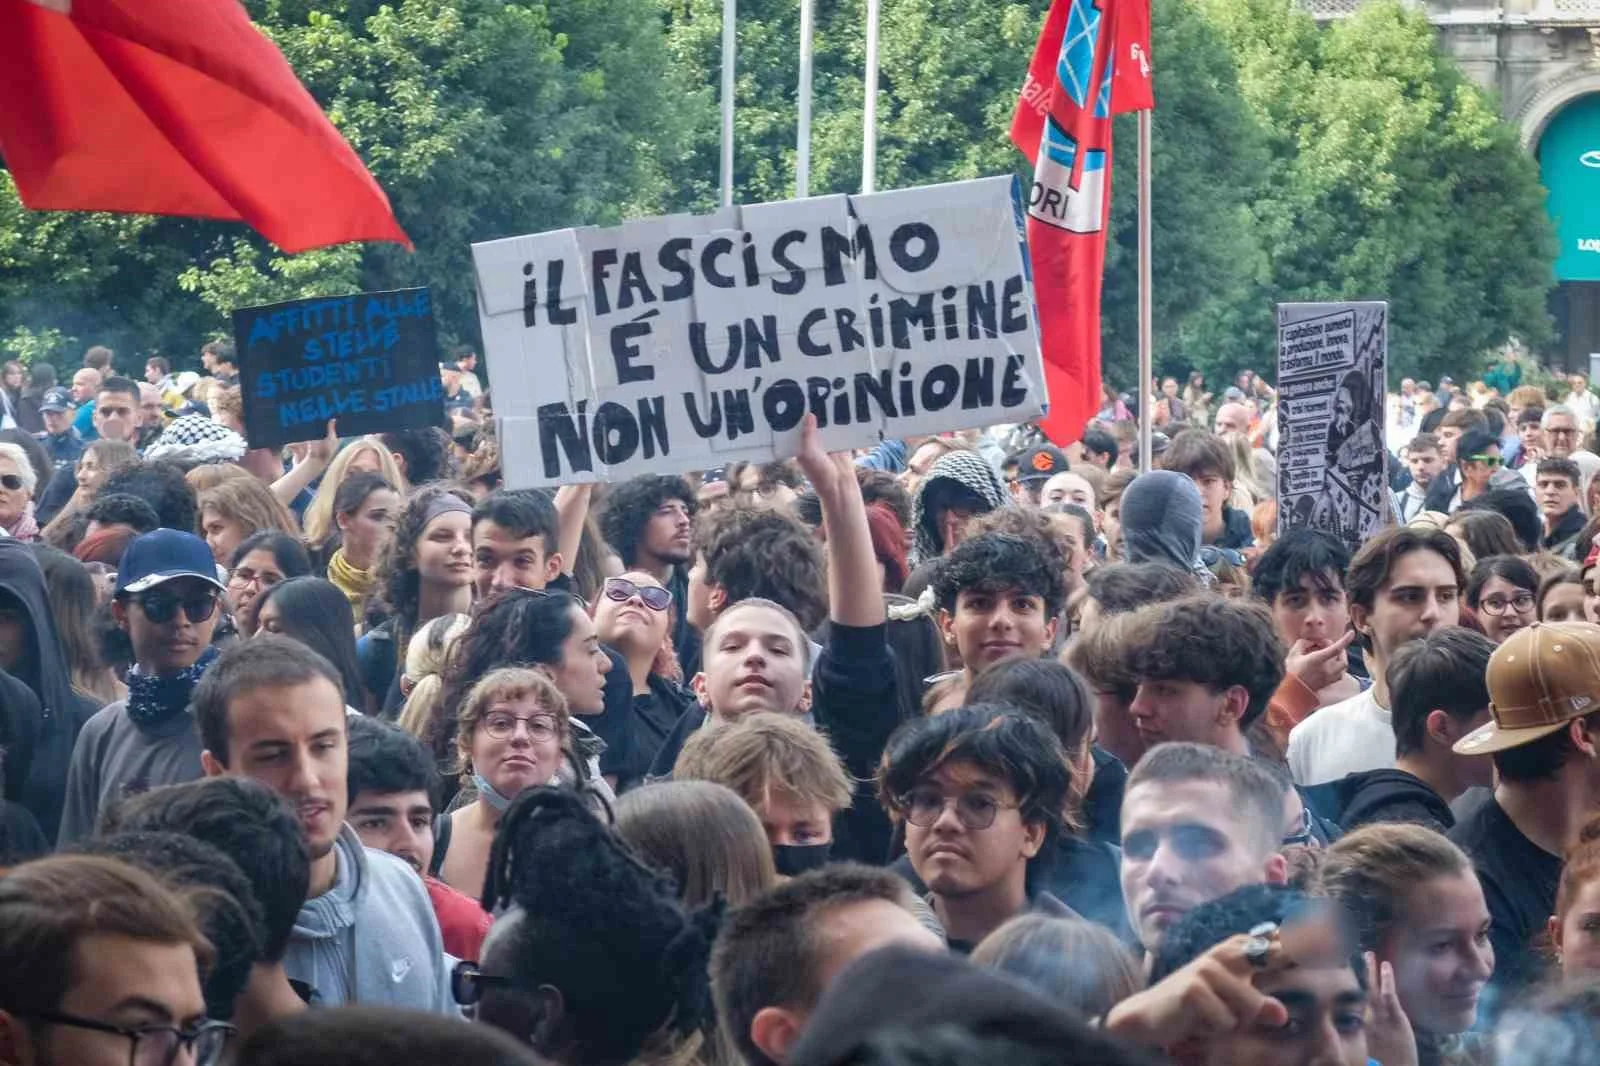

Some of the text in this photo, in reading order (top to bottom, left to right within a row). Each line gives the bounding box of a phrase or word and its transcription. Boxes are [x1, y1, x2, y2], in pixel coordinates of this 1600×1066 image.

[248, 299, 354, 346] AFFITTI
[610, 308, 660, 385] É
[688, 315, 781, 374] UN
[256, 358, 392, 398] STUDENTI
[537, 396, 670, 478] NON
